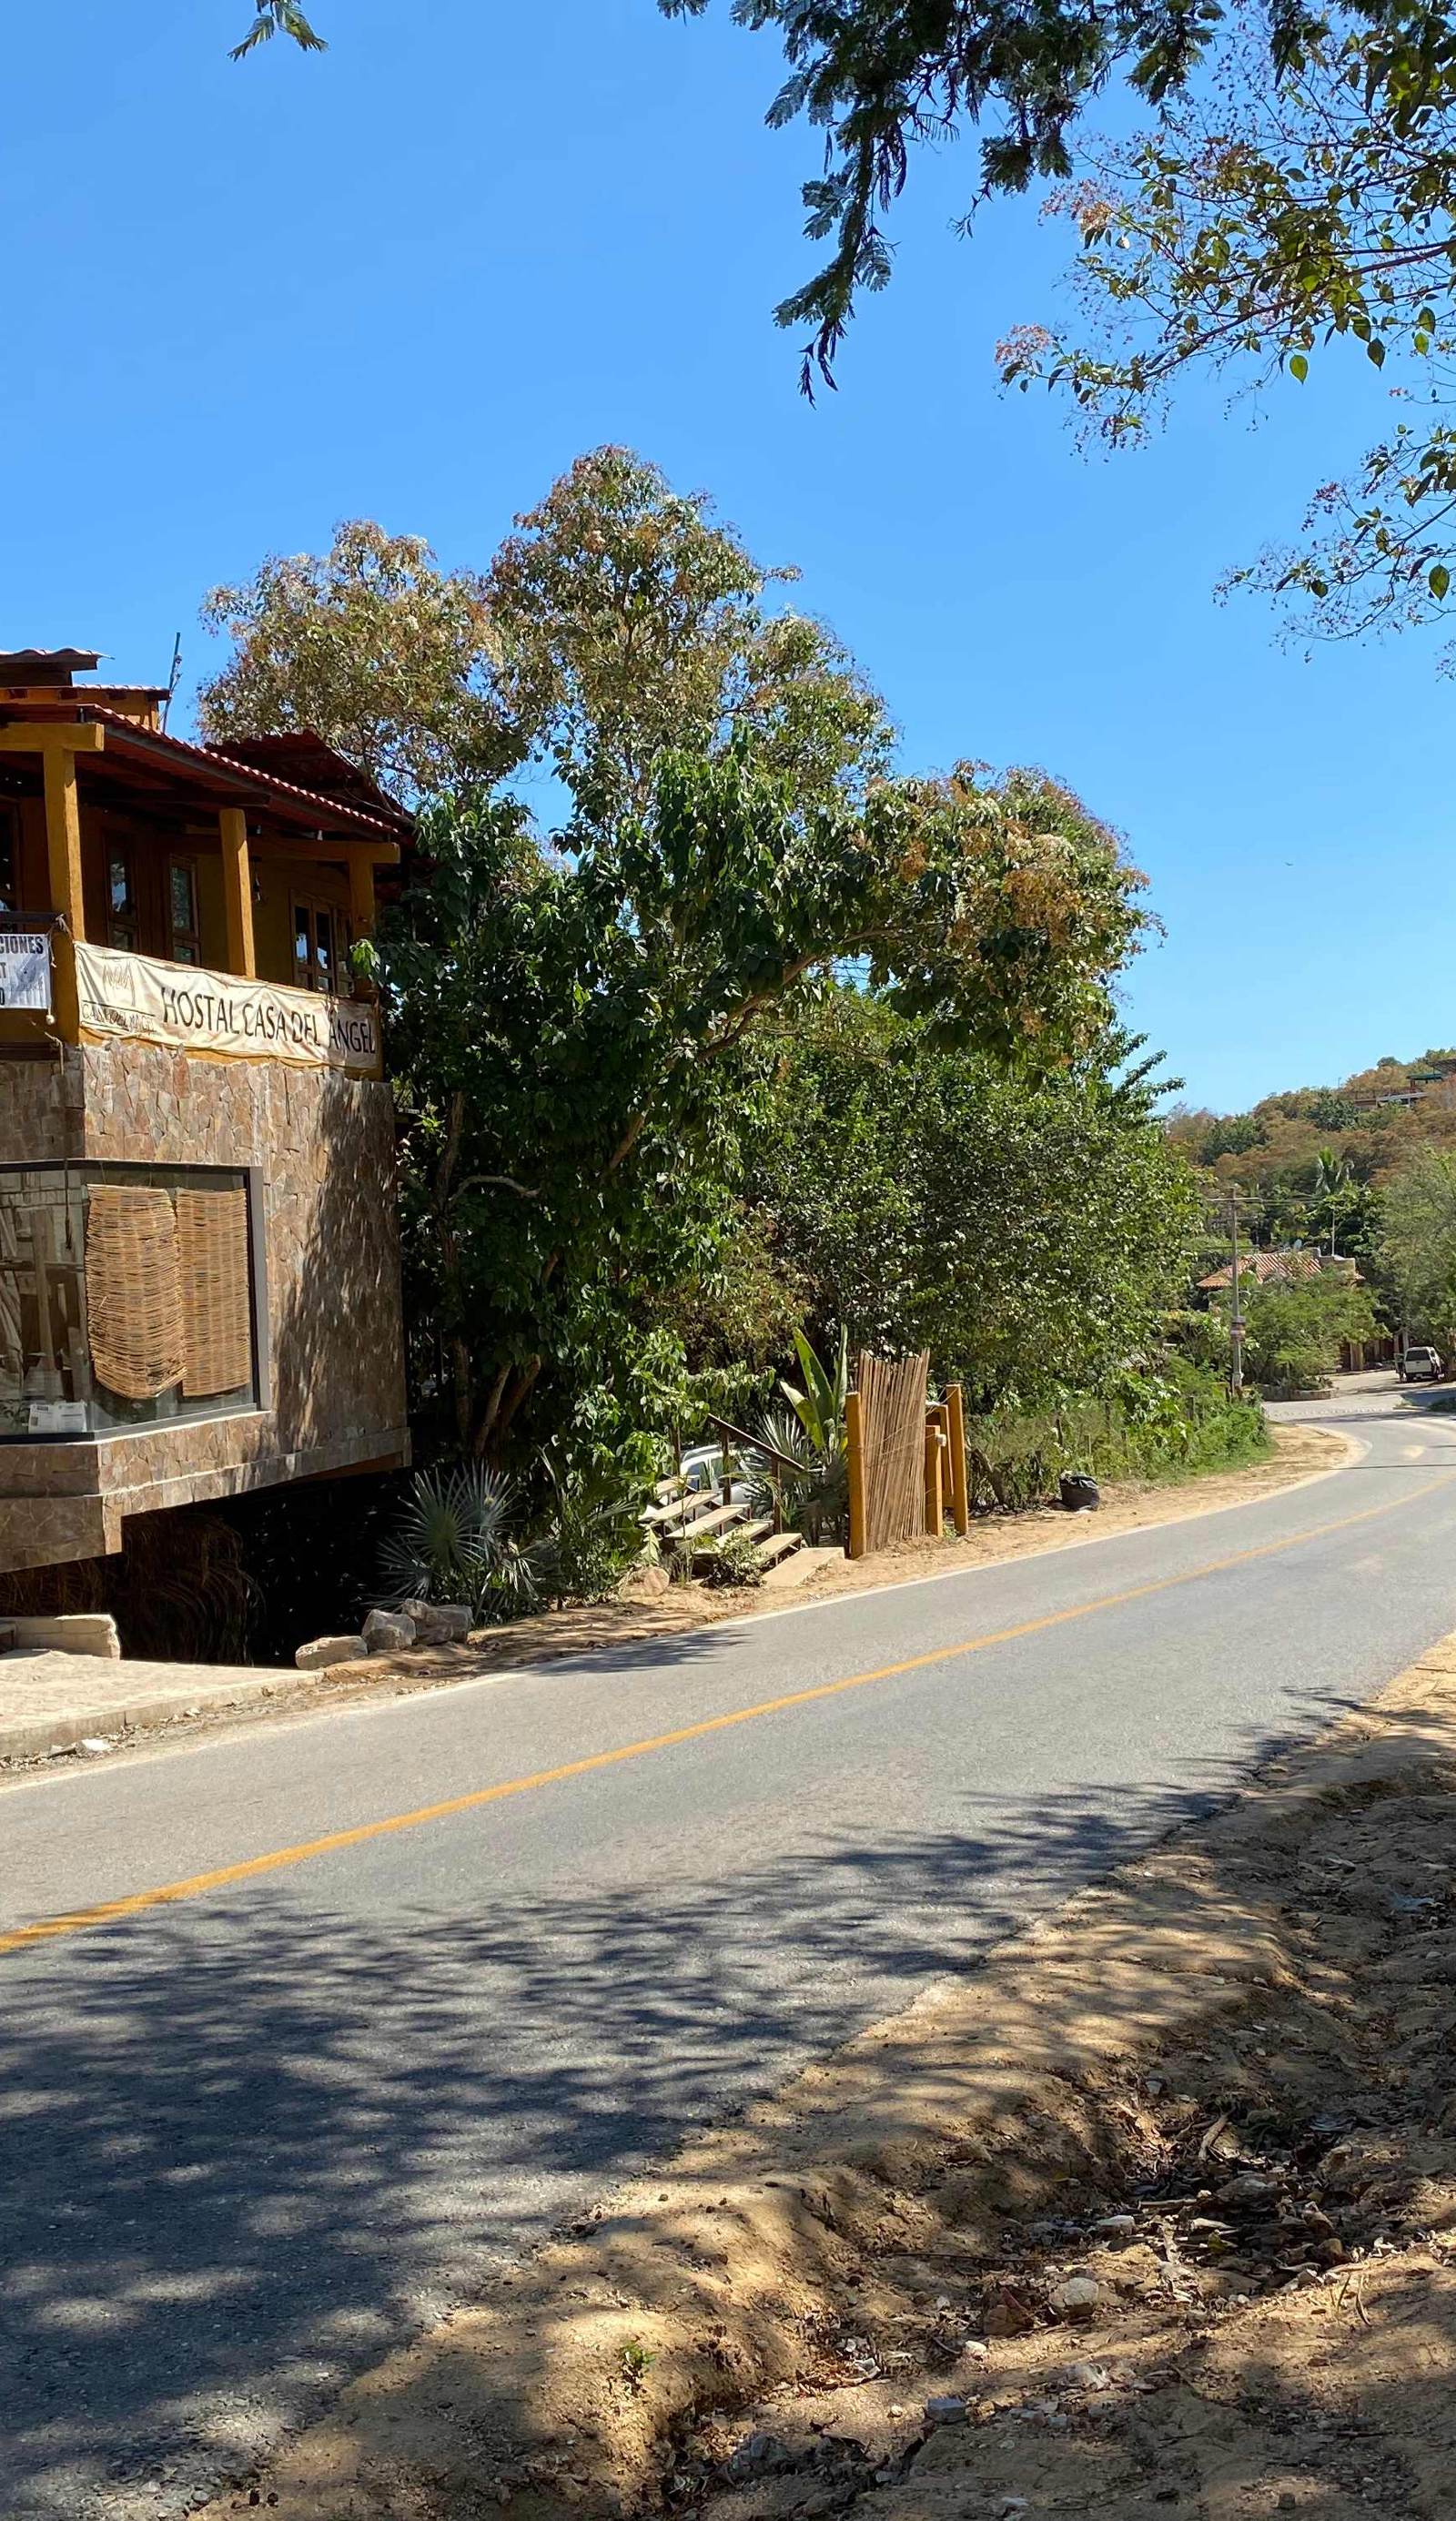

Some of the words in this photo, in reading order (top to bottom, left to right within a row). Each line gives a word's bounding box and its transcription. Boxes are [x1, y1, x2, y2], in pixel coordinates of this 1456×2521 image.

[161, 987, 239, 1035] HOSTAL
[243, 1003, 288, 1041] CASA
[291, 1011, 320, 1046] DEL
